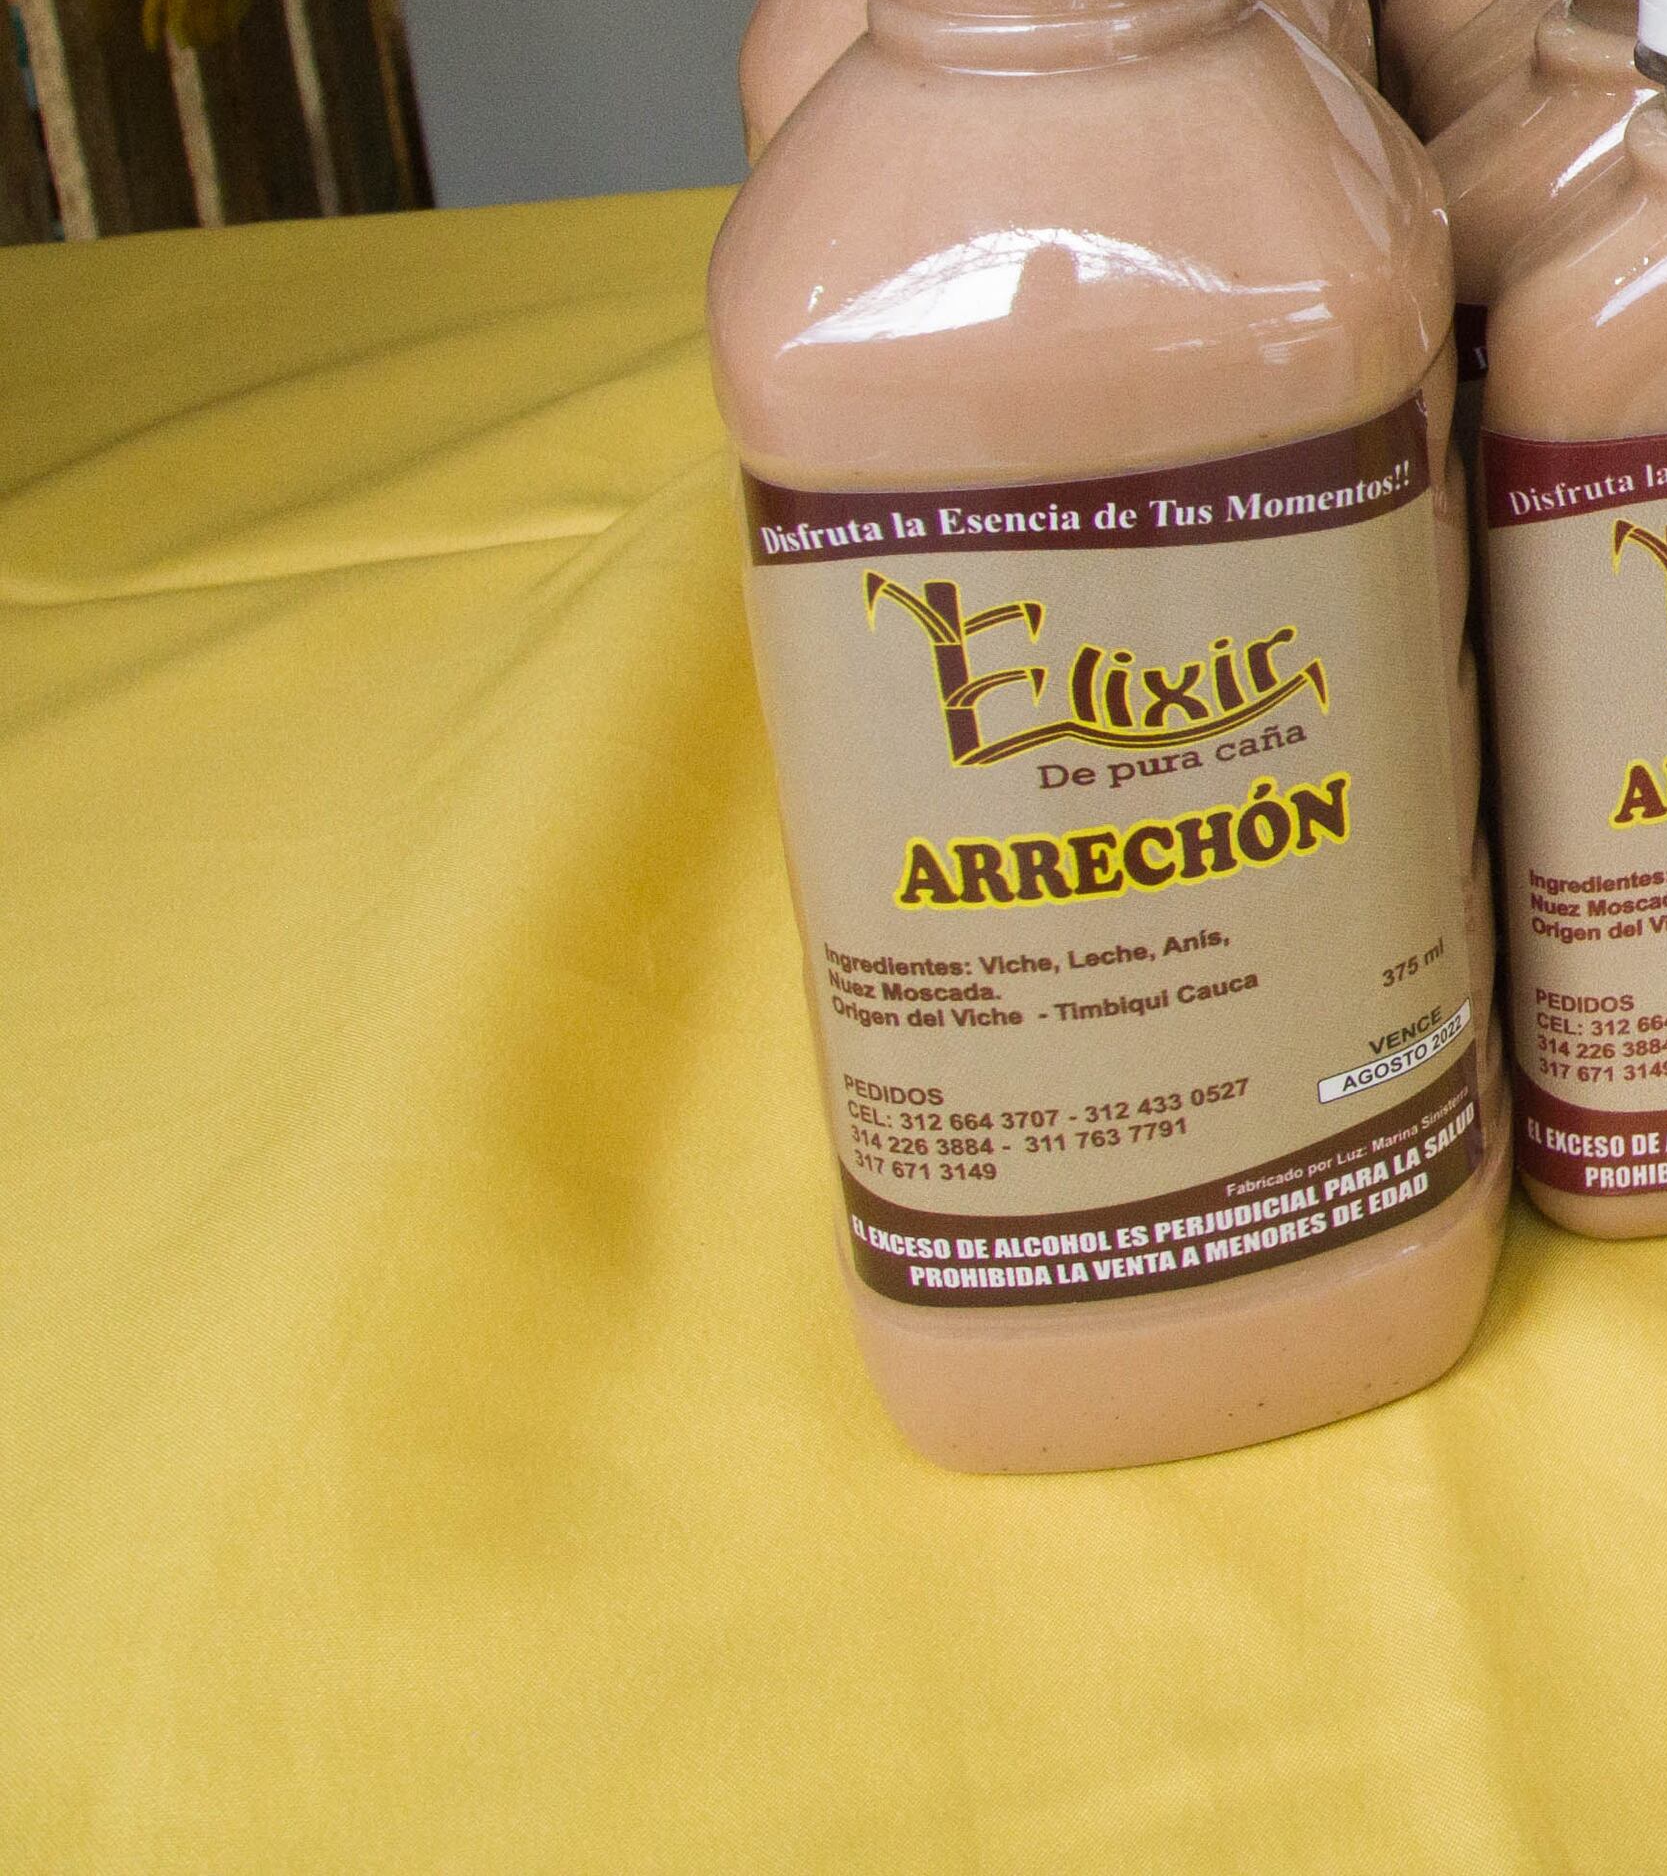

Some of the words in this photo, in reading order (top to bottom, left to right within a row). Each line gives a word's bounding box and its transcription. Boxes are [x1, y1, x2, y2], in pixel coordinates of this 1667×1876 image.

[760, 519, 883, 556] Disfruta
[892, 512, 926, 539] la
[939, 502, 1080, 538] Esencia
[1094, 501, 1137, 531] de
[1149, 497, 1212, 528] Tus
[1227, 460, 1410, 523] Momentos!!
[1510, 470, 1635, 516] Disfruta
[861, 568, 1330, 768] Elixir
[1038, 761, 1095, 790] De
[1109, 747, 1203, 789] pura
[1215, 722, 1308, 759] caña
[894, 771, 1352, 911] ARRECHÓN
[825, 942, 972, 978] Ingredientes:
[978, 952, 1060, 977] Viche,
[1067, 942, 1154, 974] Leche,
[1162, 928, 1231, 961] Anís,
[1382, 961, 1419, 989] 375
[1423, 938, 1445, 969] ml
[828, 971, 875, 1002] Nuez
[881, 981, 1001, 1002] Moscada.
[832, 994, 896, 1028] Origen
[902, 1006, 943, 1028] del
[950, 1006, 1023, 1028] Viche
[1177, 970, 1259, 1004] Cauca
[1536, 989, 1634, 1013] PEDIDOS
[1369, 1006, 1443, 1056] VENCE
[1537, 1012, 1585, 1036] CEL:
[1590, 1015, 1631, 1037] 312
[1342, 1040, 1428, 1092] AGOSTO
[1431, 1013, 1465, 1055] 2022
